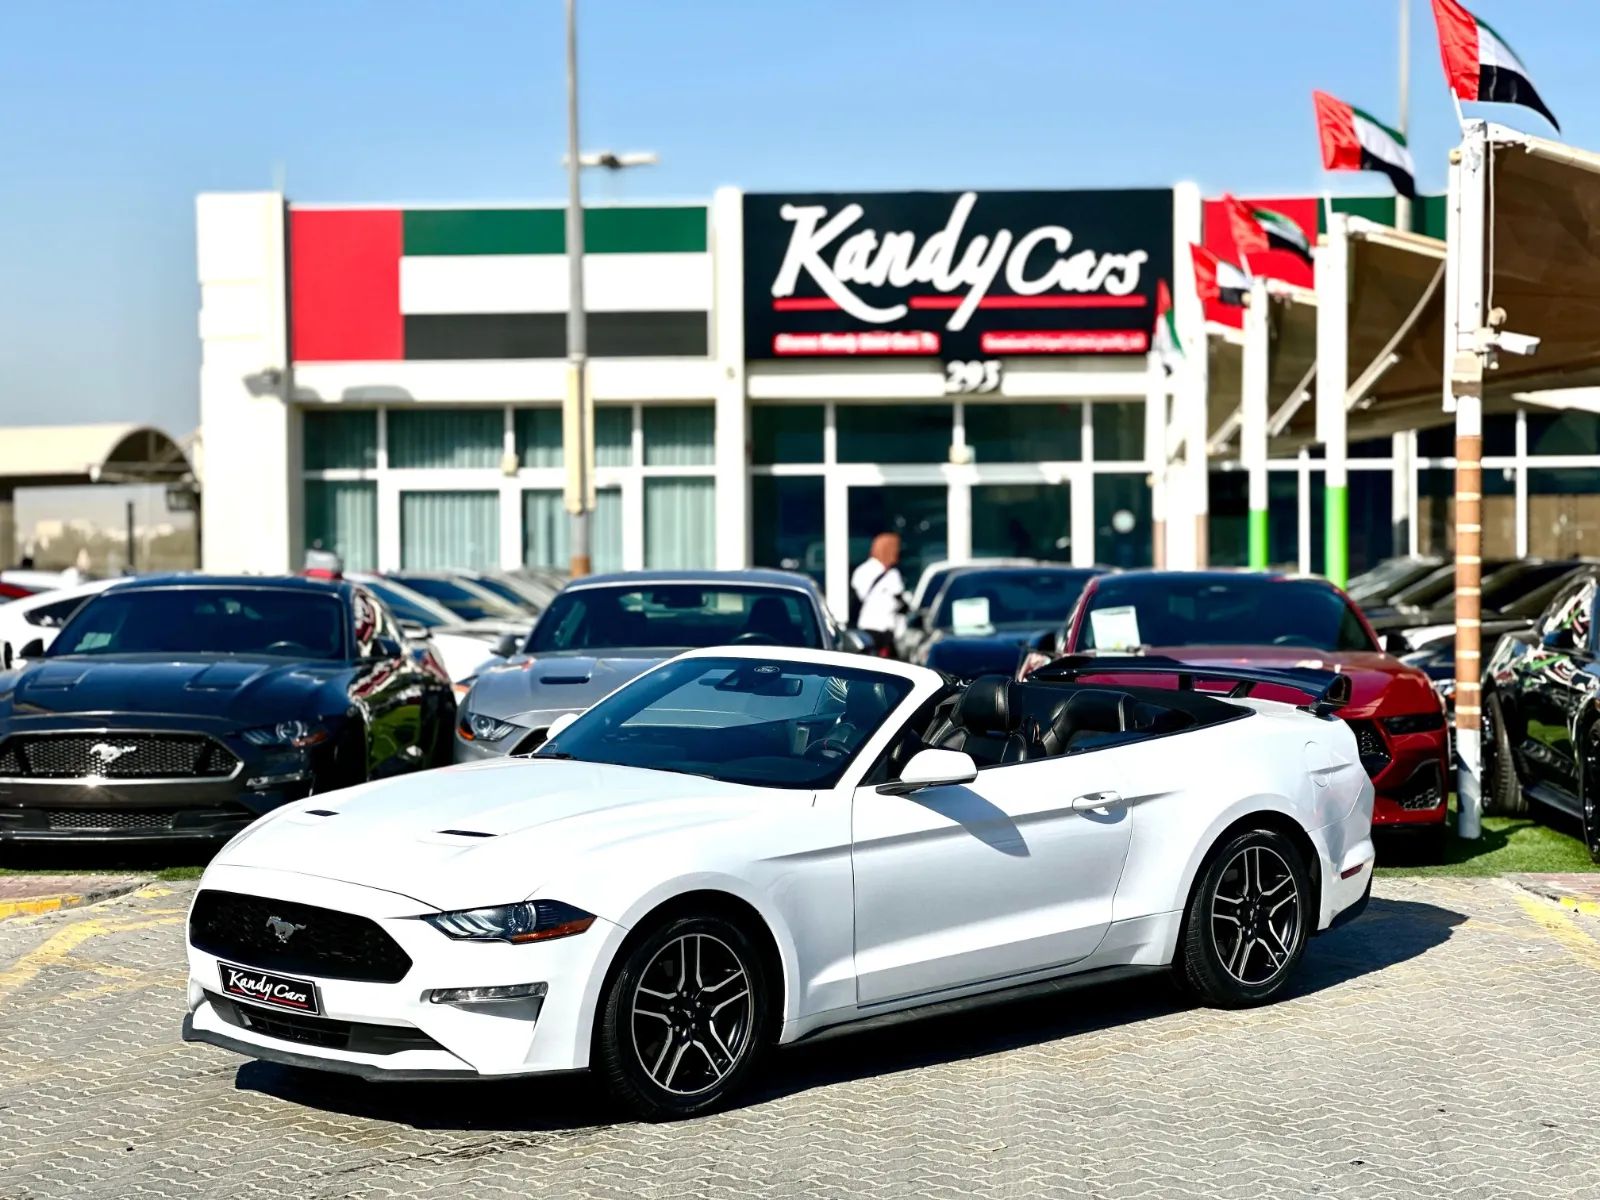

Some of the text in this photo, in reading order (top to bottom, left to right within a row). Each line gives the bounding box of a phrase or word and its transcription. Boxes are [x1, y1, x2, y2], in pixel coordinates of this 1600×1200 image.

[771, 191, 1149, 332] Kandy Cars
[228, 968, 307, 1003] Kandy Cars
